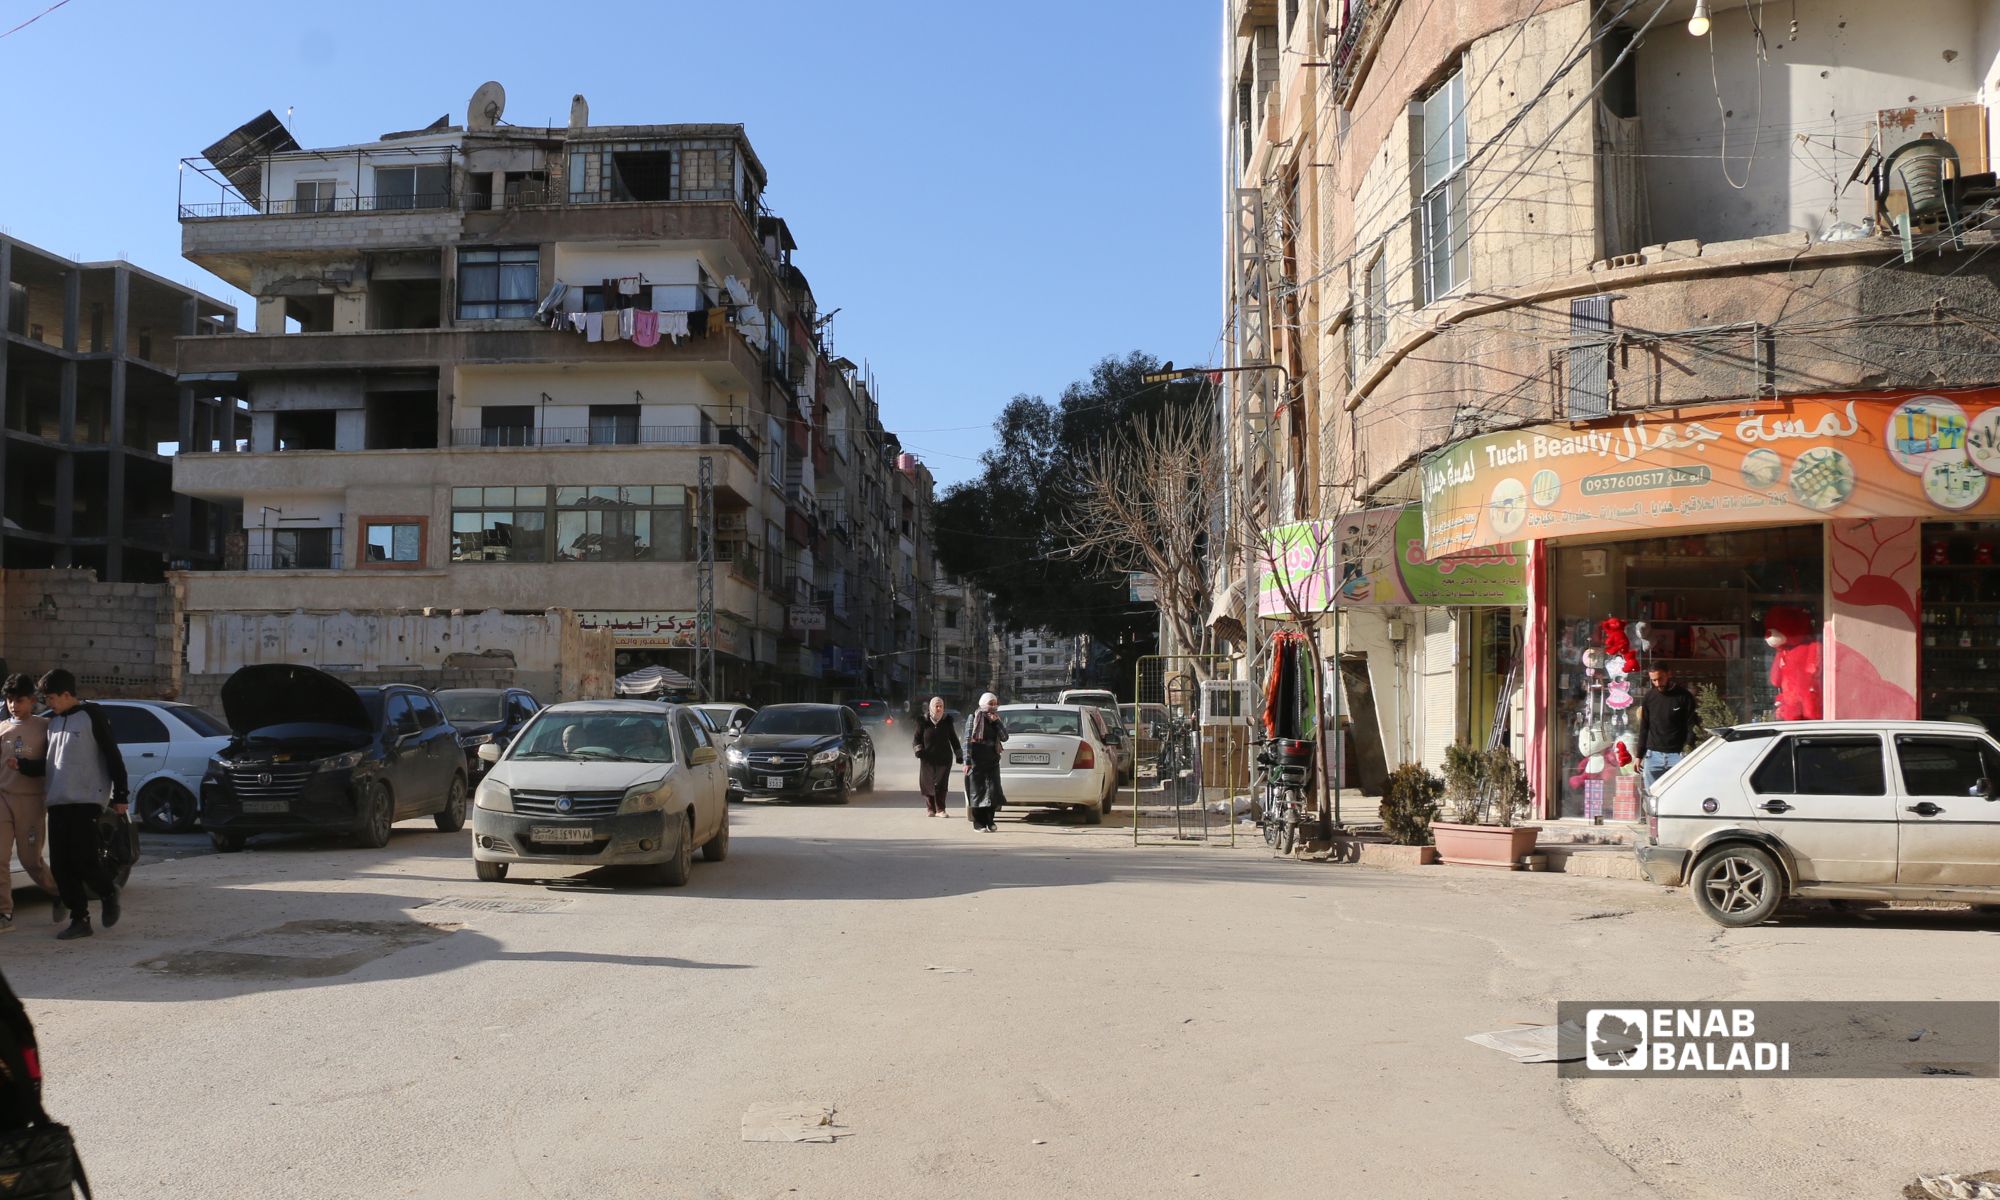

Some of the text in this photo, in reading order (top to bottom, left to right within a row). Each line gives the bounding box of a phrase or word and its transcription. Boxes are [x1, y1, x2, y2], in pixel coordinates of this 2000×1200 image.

[1615, 400, 1859, 462] لمسة جمال
[1486, 429, 1612, 468] Tuch Beauty
[1586, 473, 1664, 492] 0937600517
[578, 614, 695, 634] مركز المدينة
